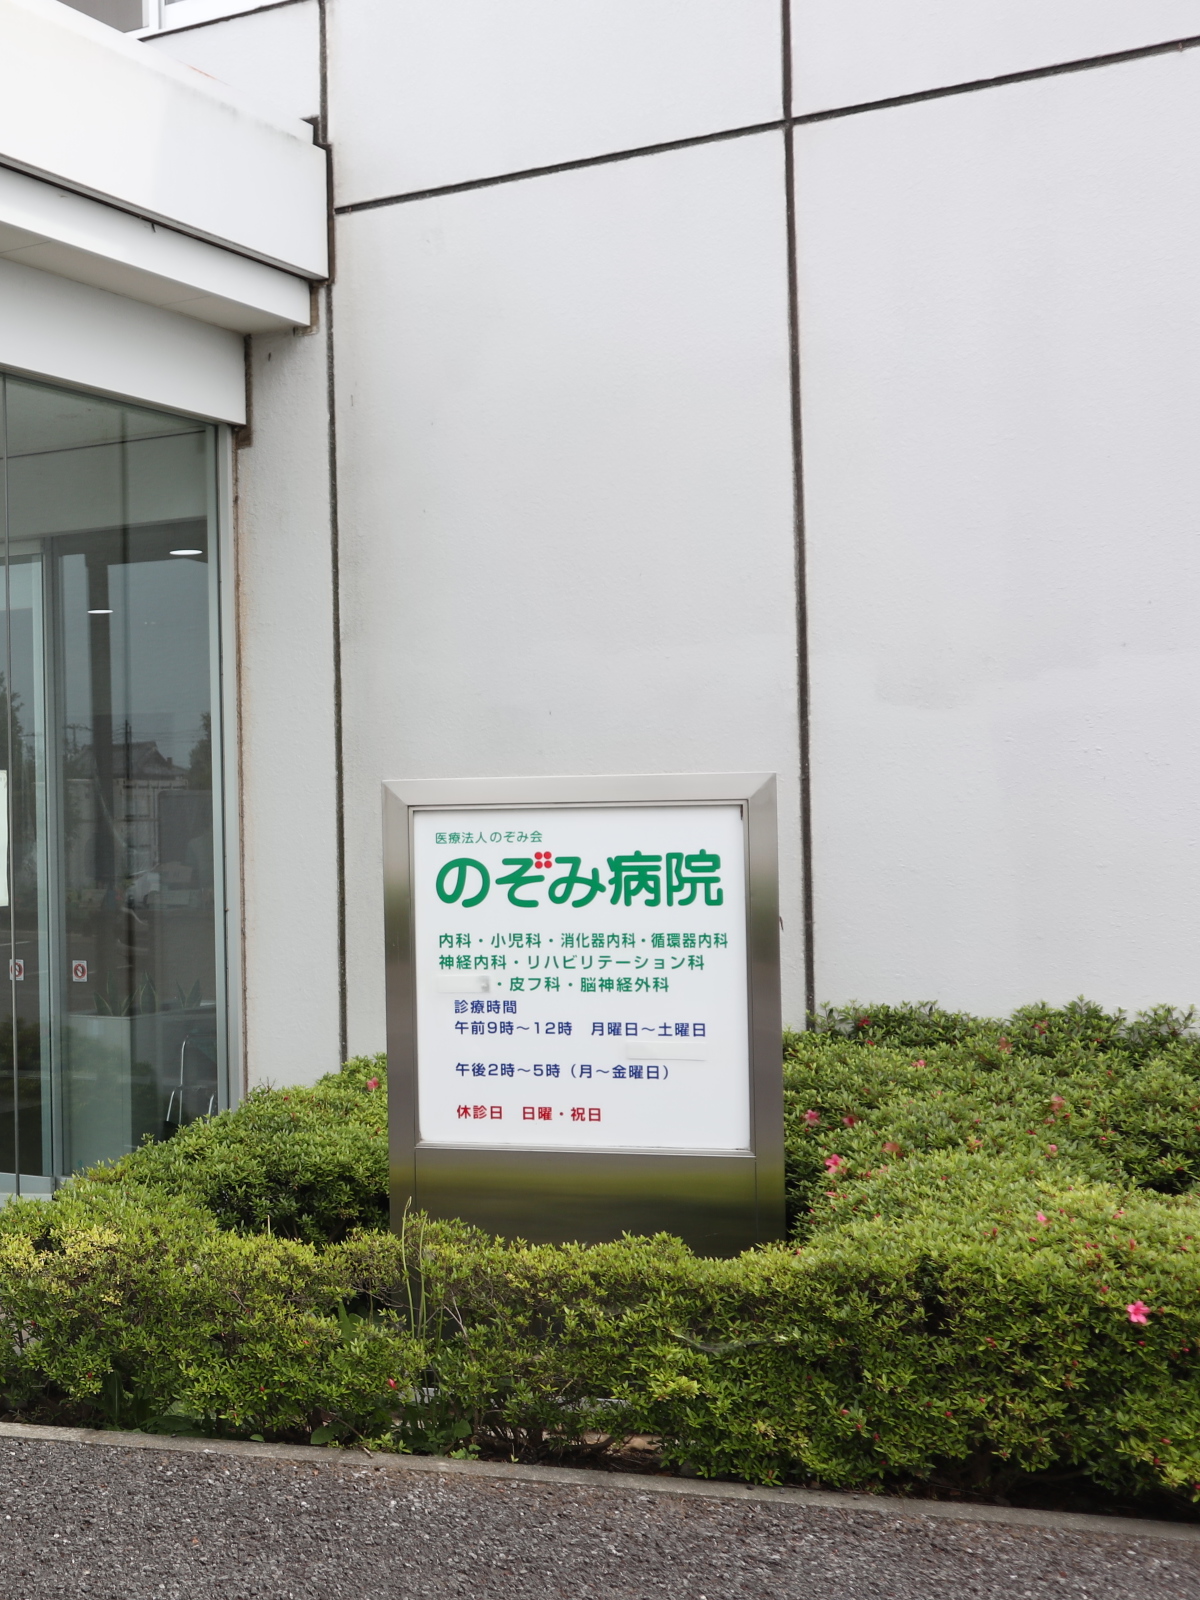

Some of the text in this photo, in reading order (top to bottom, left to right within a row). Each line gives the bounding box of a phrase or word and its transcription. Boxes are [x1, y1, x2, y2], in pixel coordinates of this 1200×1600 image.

[435, 830, 543, 844] 医療法人のぞみ会
[435, 848, 724, 909] のぞみ病院
[438, 932, 729, 949] 内科・小児科・消化器内科・循環器内科
[438, 954, 705, 971] 神経内科・リハビリテーション科
[454, 999, 518, 1014] 診療時間
[456, 1105, 602, 1122] 休診日 日曜・祝日
